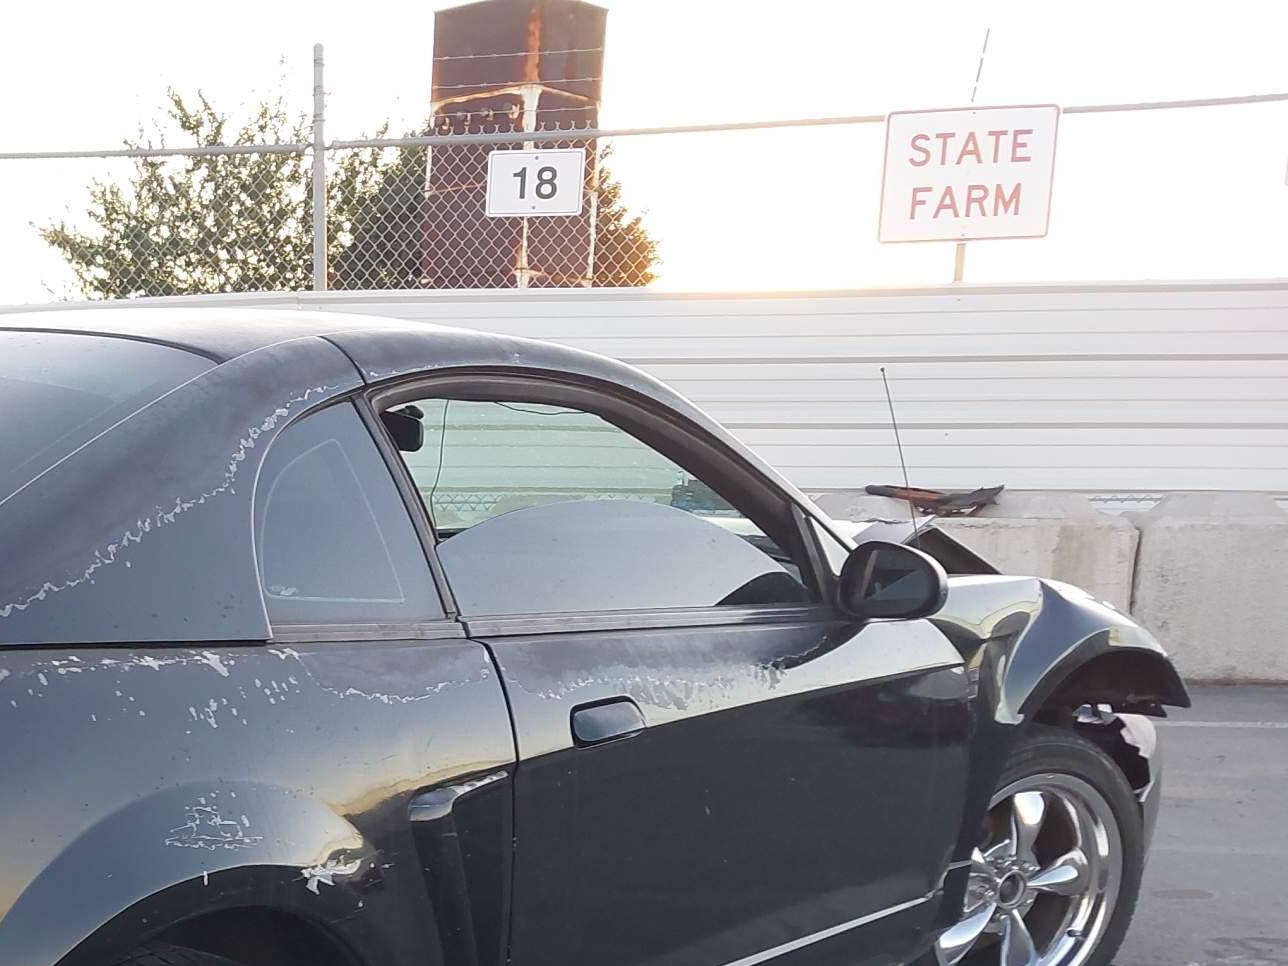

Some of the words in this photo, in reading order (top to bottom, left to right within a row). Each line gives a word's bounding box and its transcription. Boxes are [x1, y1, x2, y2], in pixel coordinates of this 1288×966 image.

[909, 127, 1033, 168] STATE
[512, 165, 558, 201] 18
[910, 182, 1023, 220] FARM
